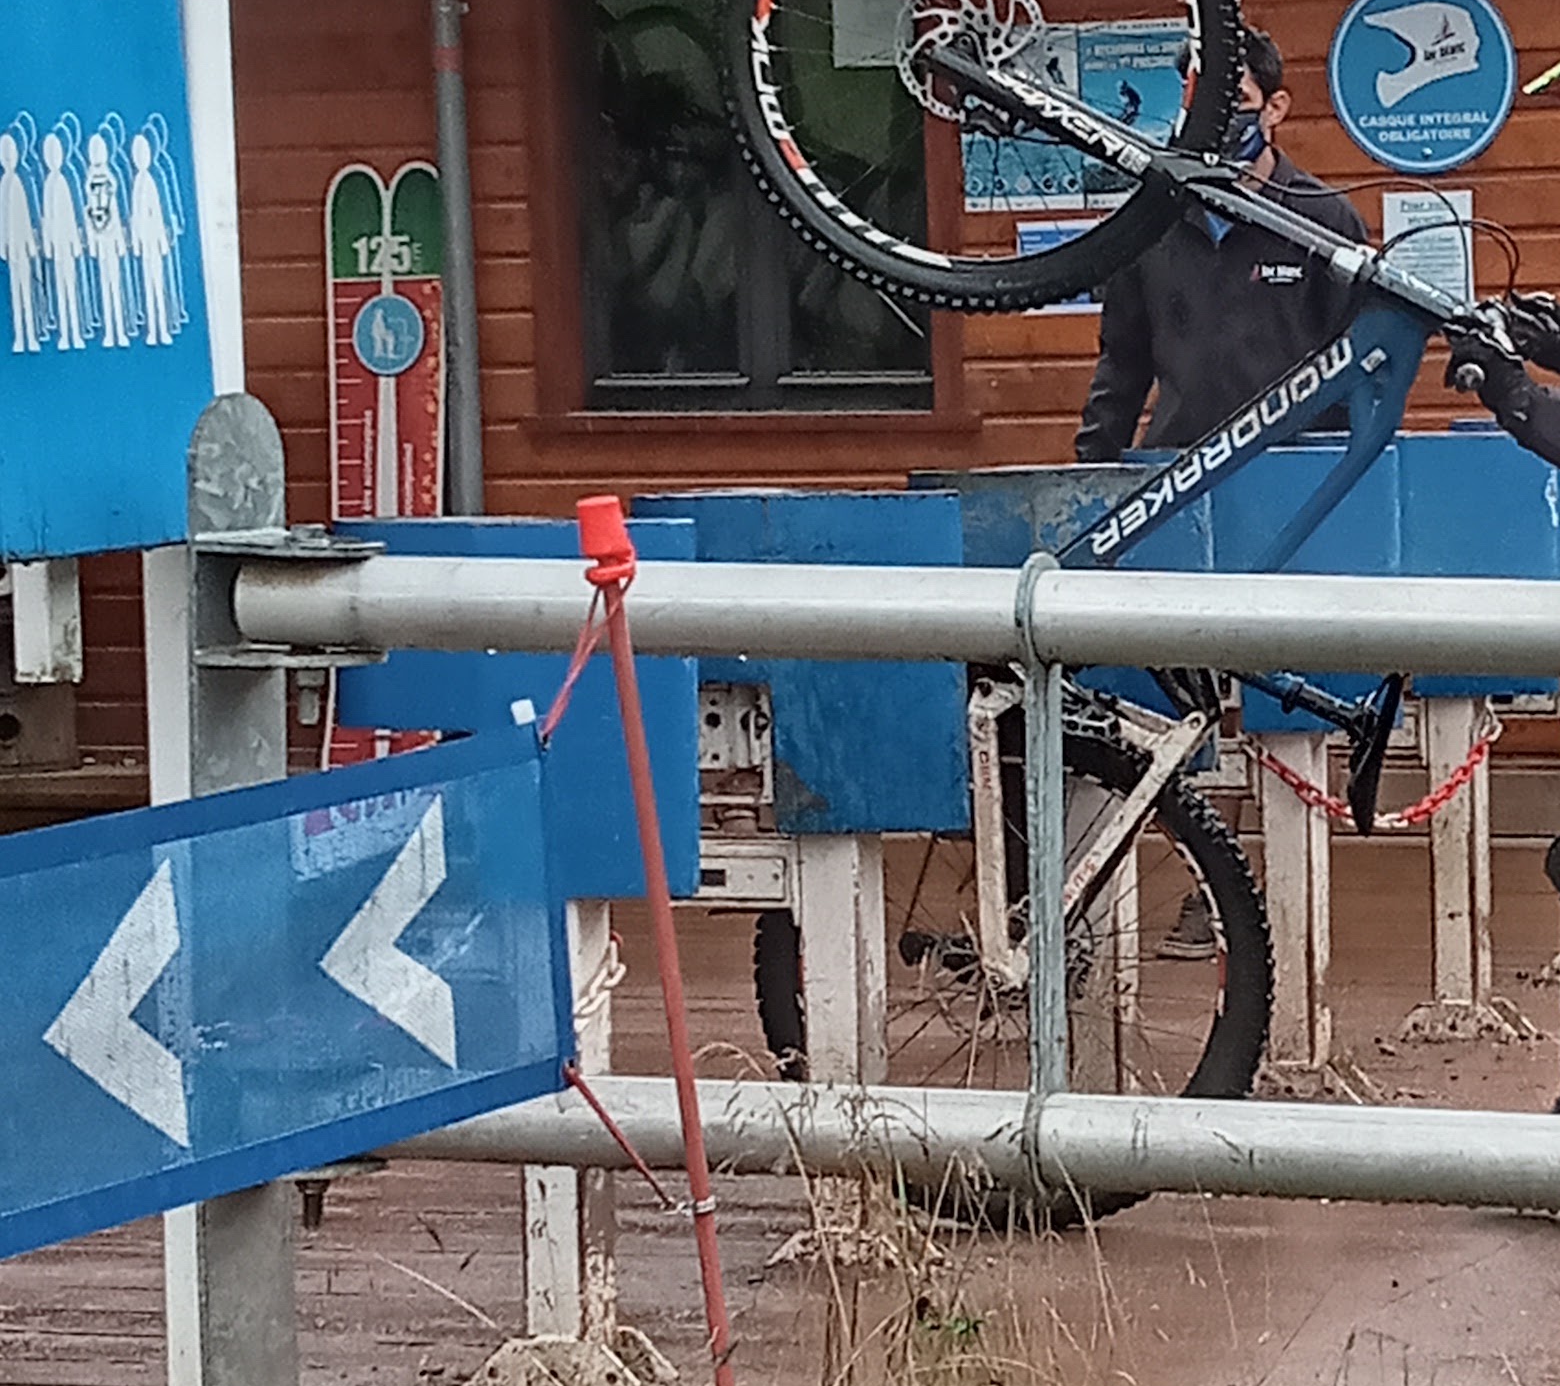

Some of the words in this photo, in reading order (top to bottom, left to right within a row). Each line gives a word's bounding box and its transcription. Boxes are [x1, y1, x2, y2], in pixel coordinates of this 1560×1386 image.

[1358, 114, 1416, 128] CASQUE
[1419, 111, 1490, 127] INTEGRAL
[1377, 127, 1472, 142] OBLIGATOIRE
[351, 235, 411, 274] 125
[1091, 337, 1353, 556] MONDRAKER
